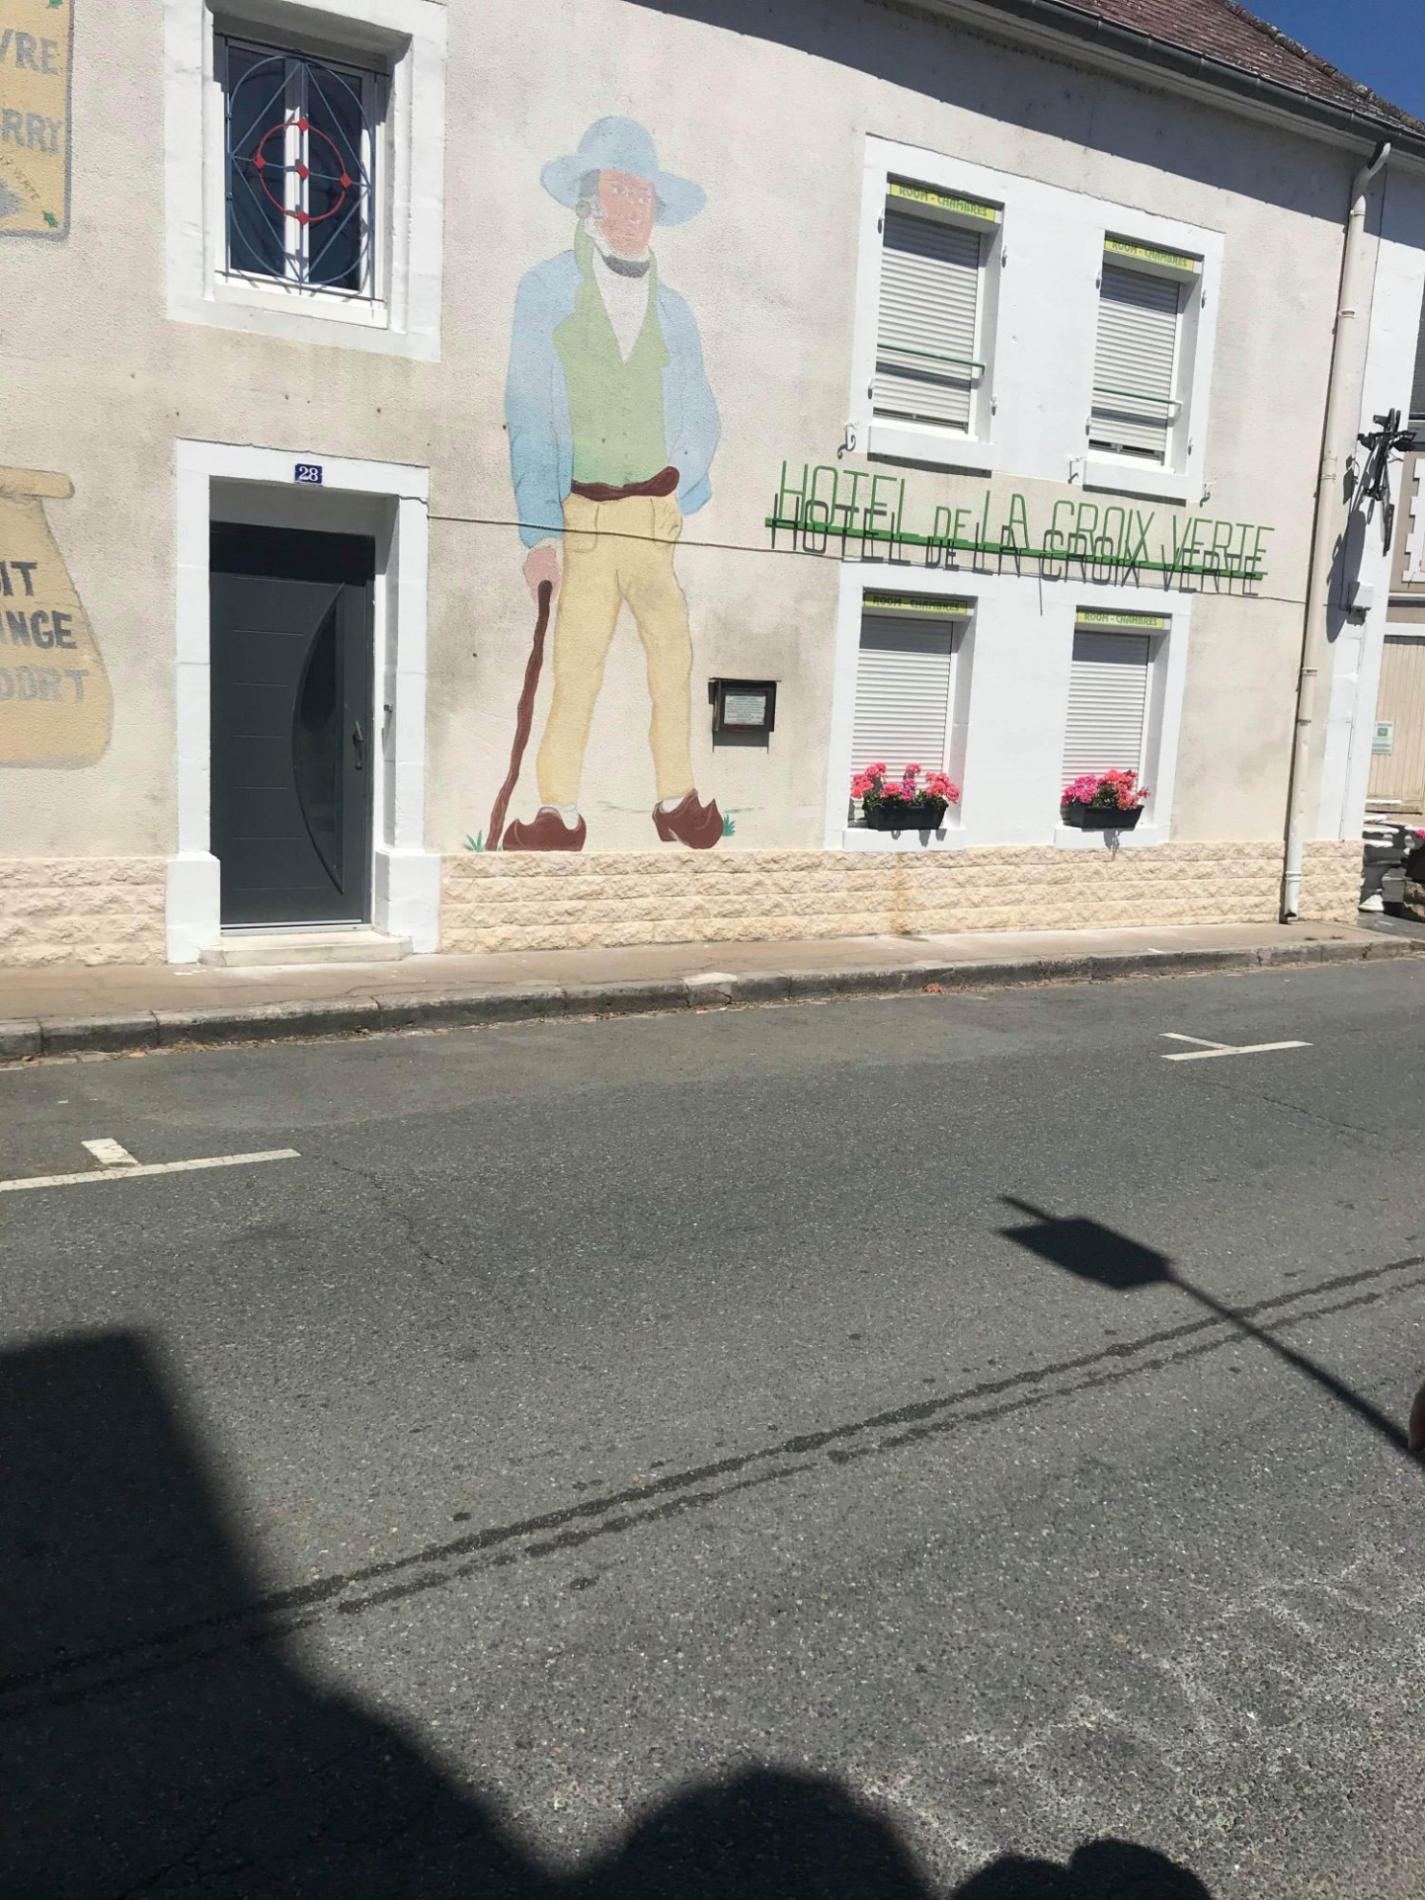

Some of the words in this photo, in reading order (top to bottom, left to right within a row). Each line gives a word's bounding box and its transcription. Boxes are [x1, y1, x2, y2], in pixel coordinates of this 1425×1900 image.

[299, 466, 318, 481] 28
[779, 460, 920, 537] HOTEL
[932, 506, 972, 543] DE
[981, 490, 1030, 549] LA
[1050, 500, 1155, 562] CROIX
[1172, 515, 1275, 575] VERTE
[0, 561, 37, 597] IT
